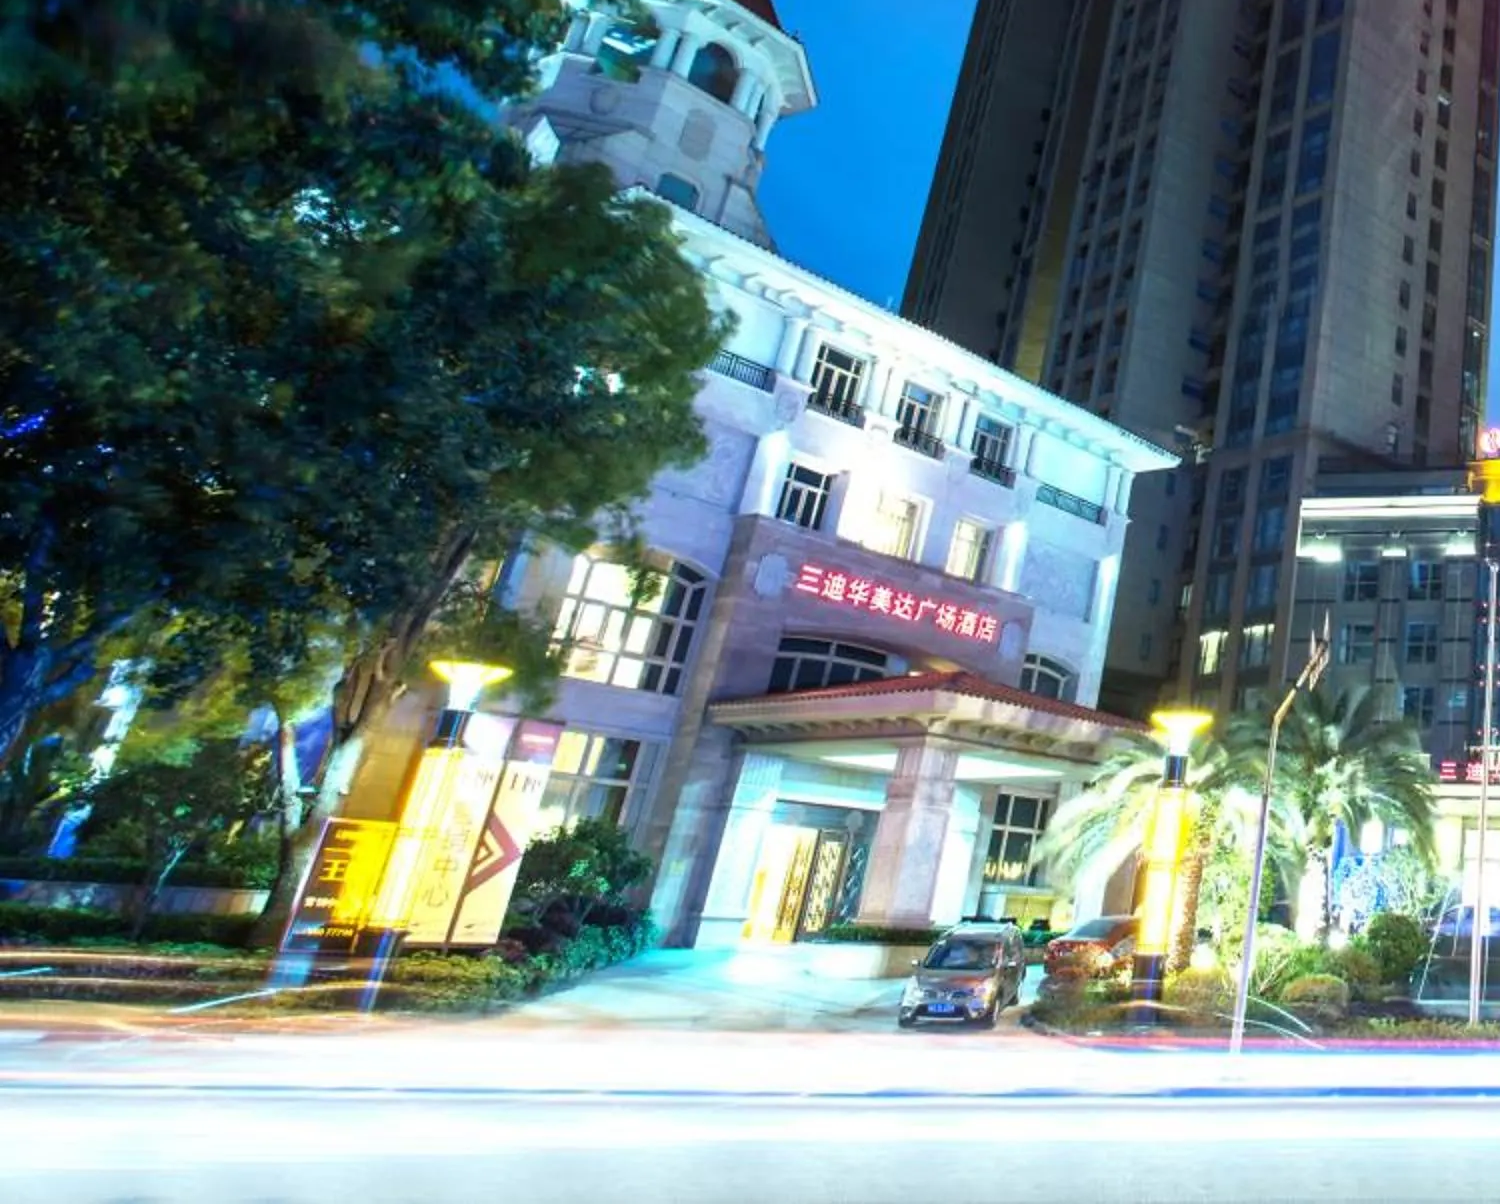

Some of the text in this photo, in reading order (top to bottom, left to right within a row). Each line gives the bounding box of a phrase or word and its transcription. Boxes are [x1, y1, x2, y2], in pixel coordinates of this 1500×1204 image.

[797, 564, 998, 642] 三迪华美达广场酒店
